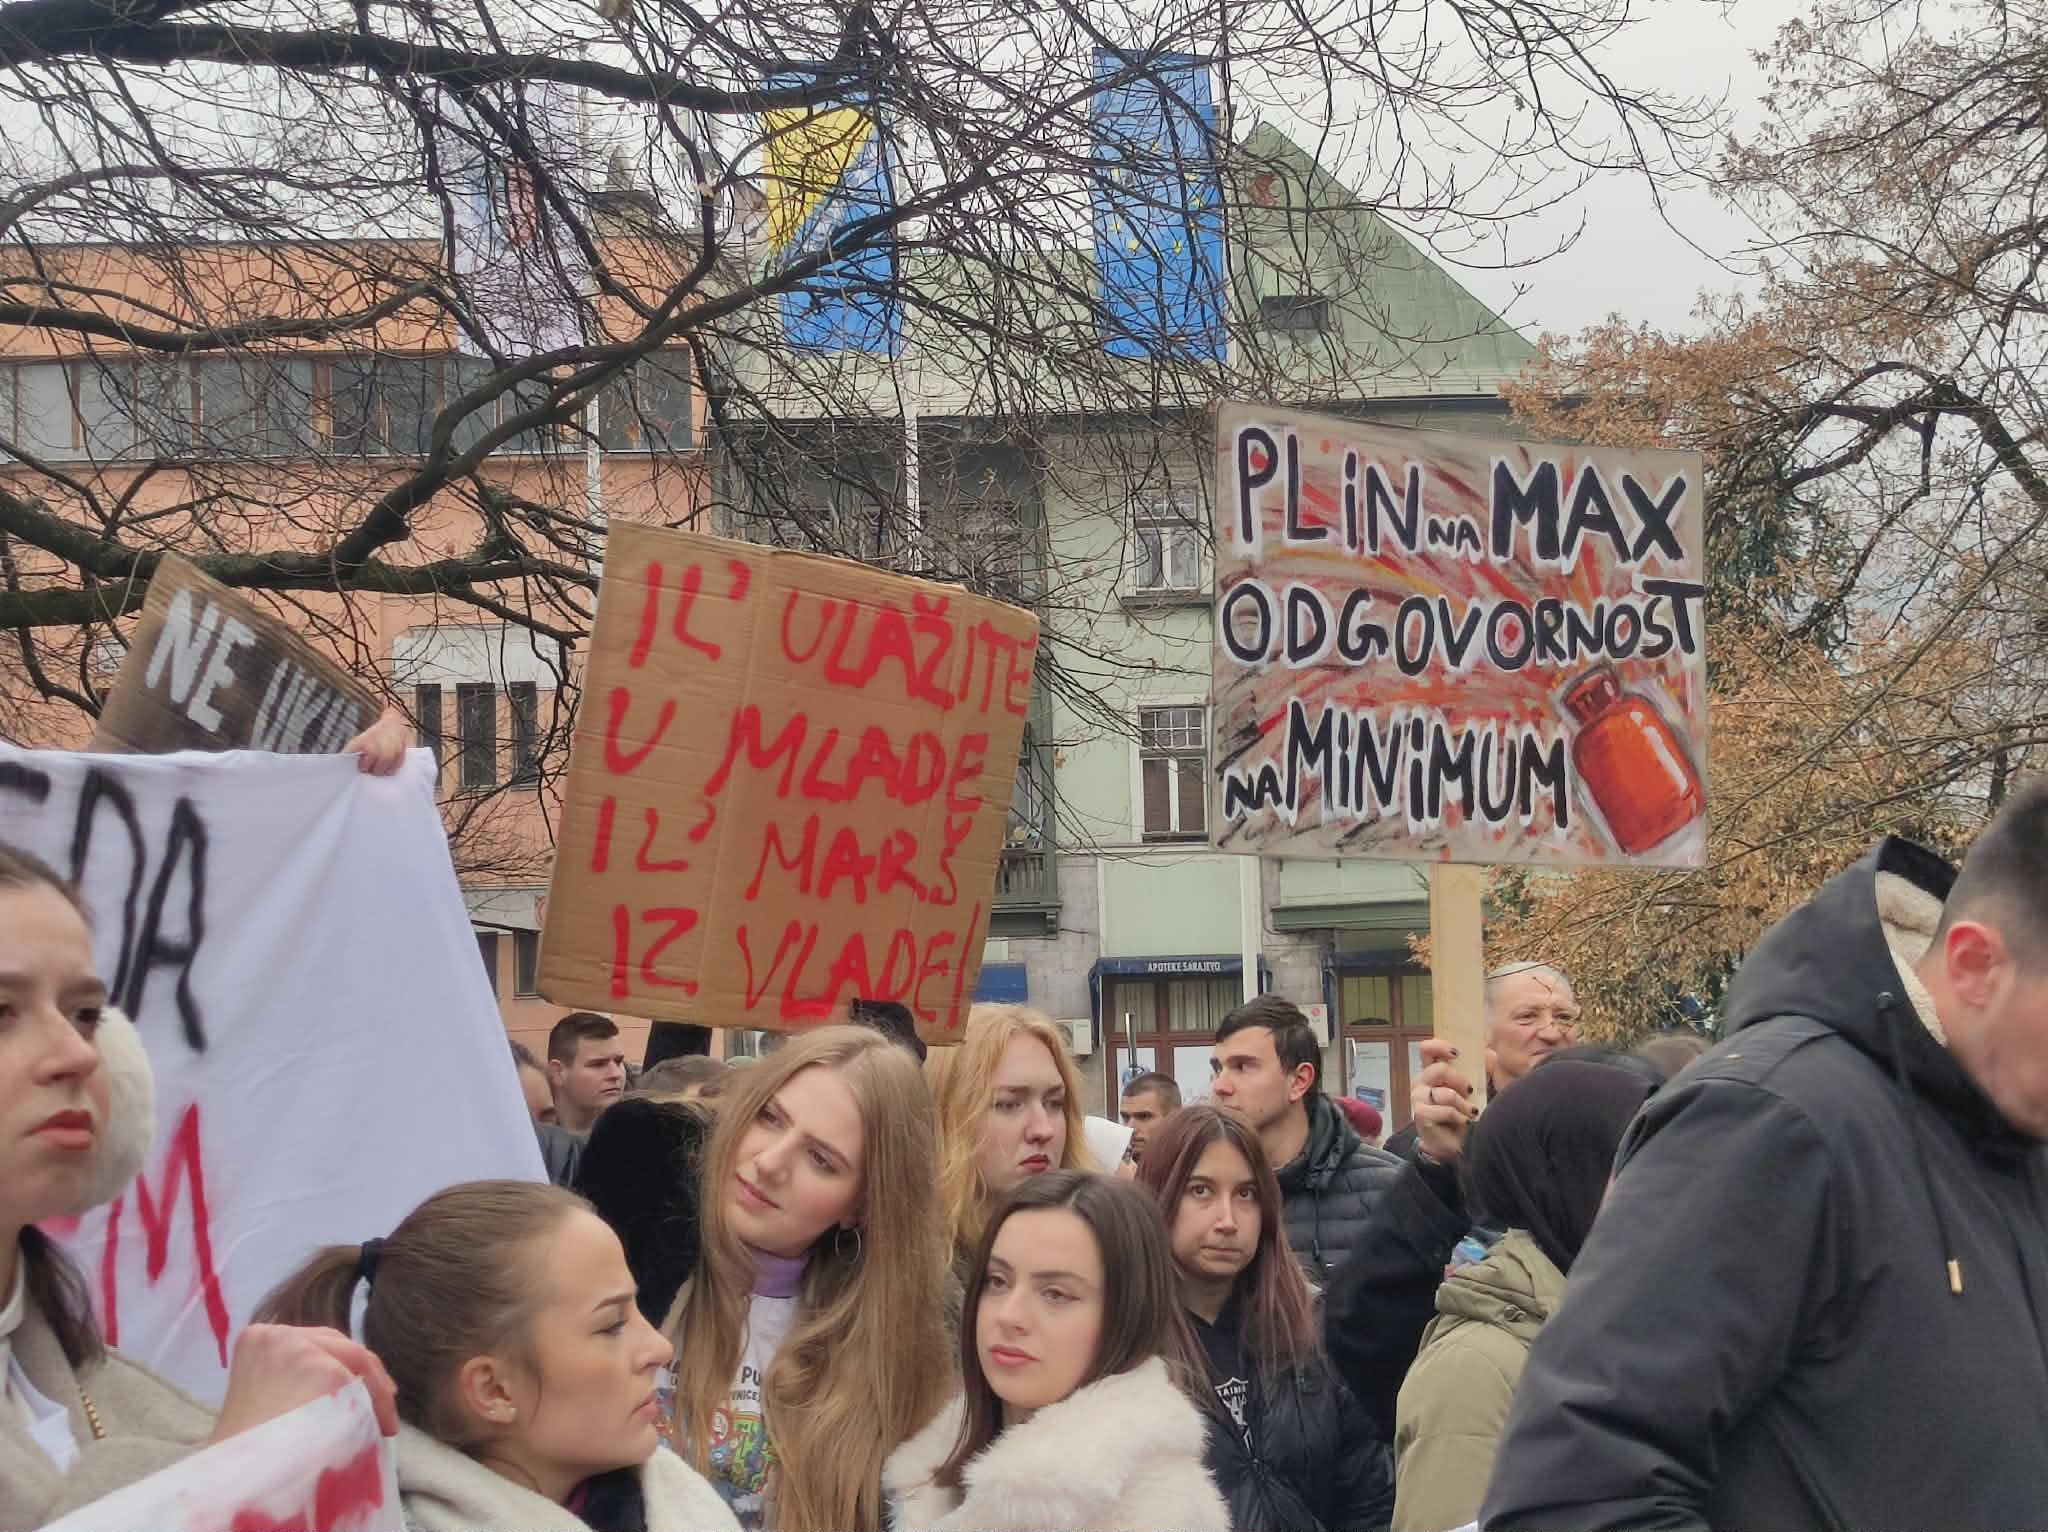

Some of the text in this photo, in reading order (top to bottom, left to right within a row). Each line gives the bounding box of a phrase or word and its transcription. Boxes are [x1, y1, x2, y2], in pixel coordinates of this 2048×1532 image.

[1427, 519, 1481, 552] NA
[1493, 460, 1686, 563] MAX
[145, 586, 256, 732] NE
[781, 591, 1038, 716] ULAŽITE
[1222, 579, 1705, 675] ODGOVORNOST
[604, 688, 989, 813] U MLADE
[1224, 774, 1282, 818] NA
[743, 814, 973, 906] MARŠ
[611, 904, 699, 999] IZ
